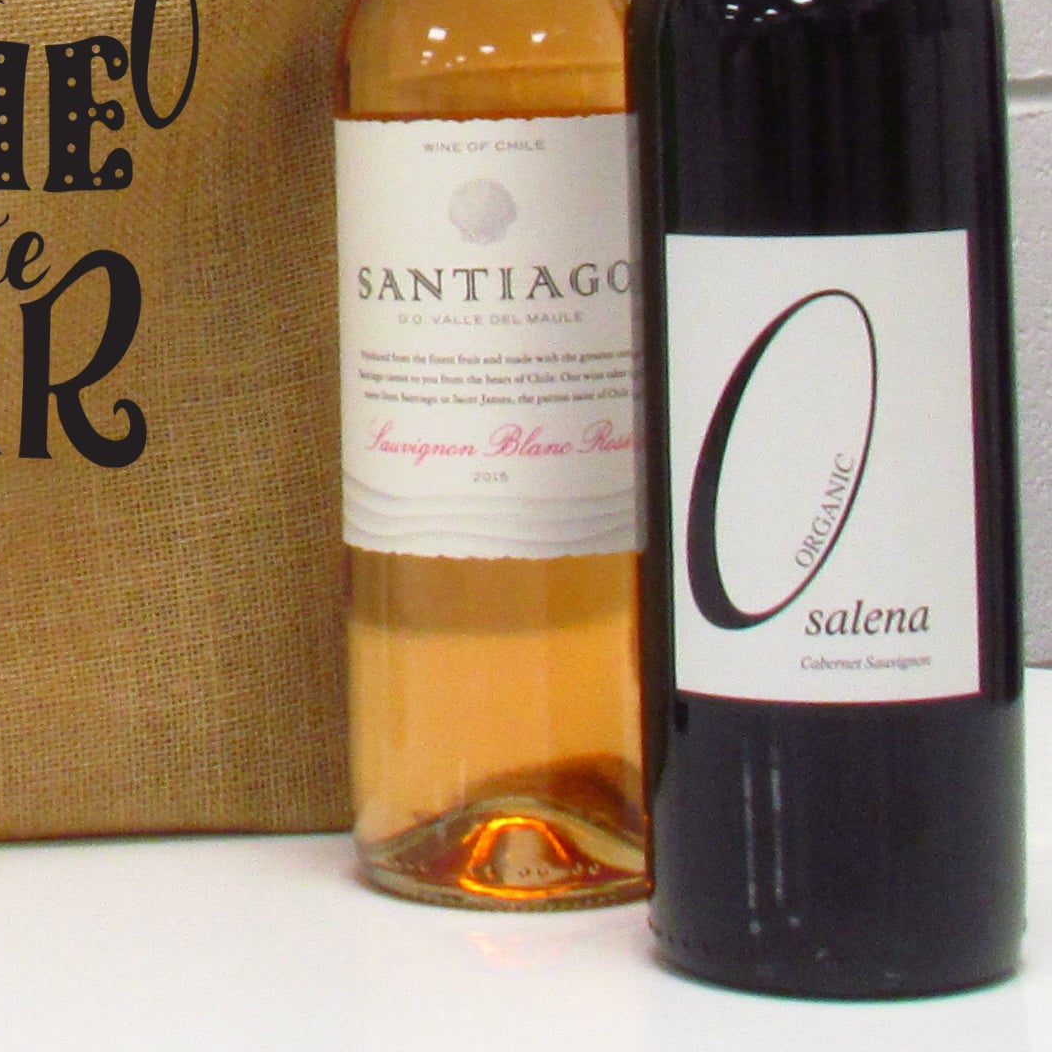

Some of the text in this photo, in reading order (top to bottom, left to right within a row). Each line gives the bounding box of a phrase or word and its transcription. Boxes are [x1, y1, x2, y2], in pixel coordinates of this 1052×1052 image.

[358, 259, 632, 301] SANTIAGO
[795, 452, 856, 569] ORGANIC
[805, 598, 931, 637] salena
